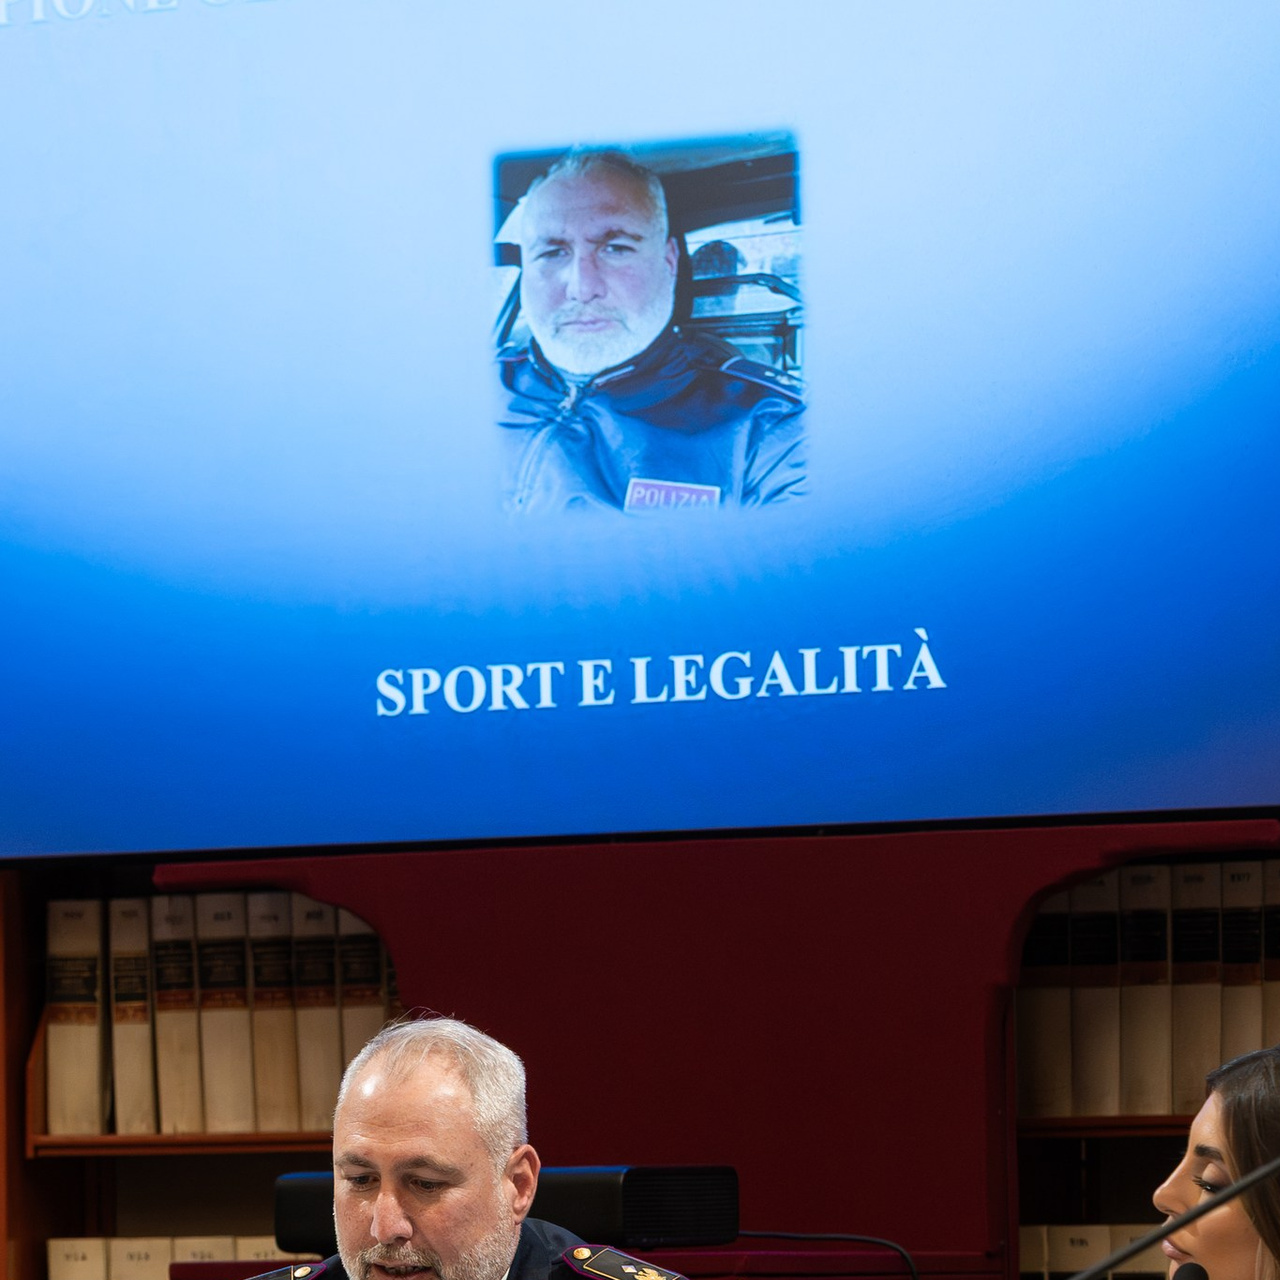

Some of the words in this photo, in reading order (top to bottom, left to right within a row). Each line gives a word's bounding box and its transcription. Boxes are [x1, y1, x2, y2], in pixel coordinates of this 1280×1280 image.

[632, 487, 710, 508] POLIZIA
[376, 661, 564, 716] SPORT
[578, 659, 615, 706] E
[630, 628, 947, 704] LEGALITÀ
